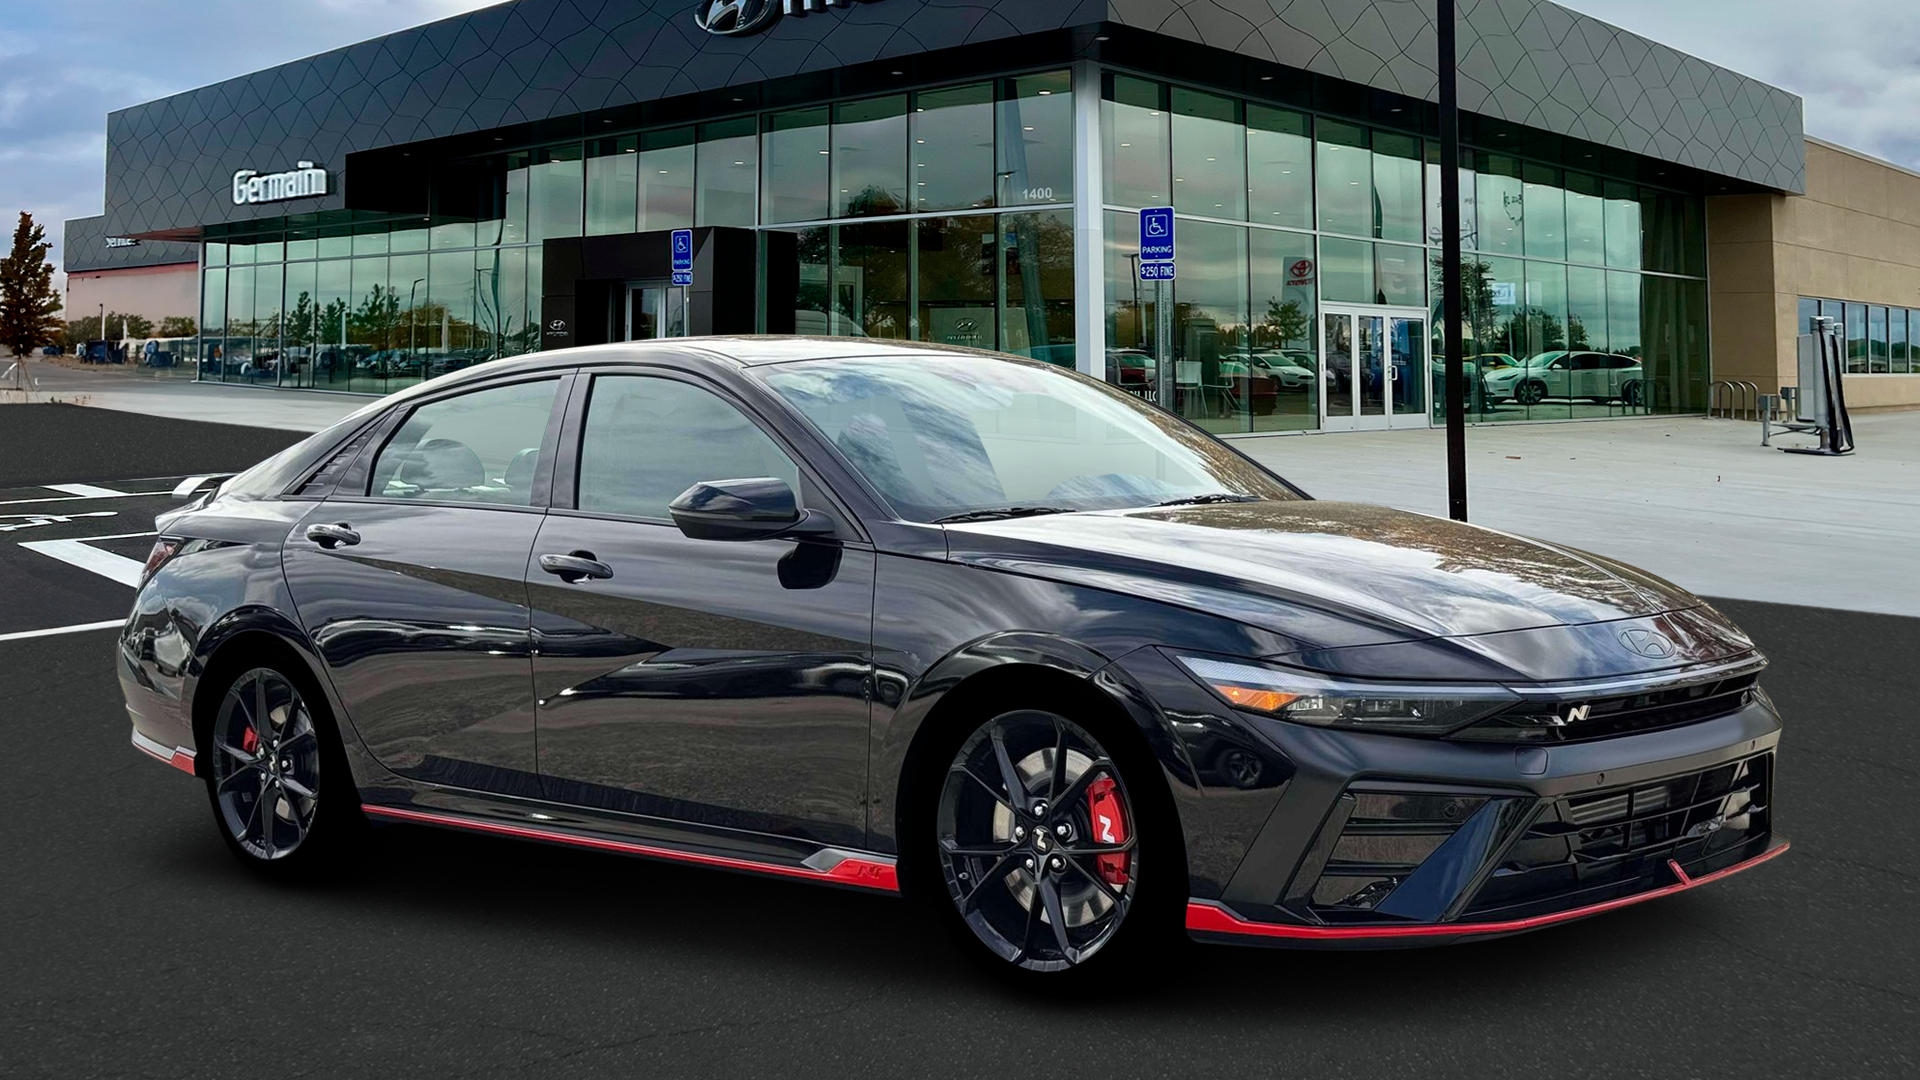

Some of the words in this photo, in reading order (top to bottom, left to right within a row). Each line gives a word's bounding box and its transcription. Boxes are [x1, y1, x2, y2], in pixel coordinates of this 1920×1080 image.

[232, 160, 328, 205] Germain
[1022, 187, 1053, 200] 1400
[1141, 245, 1173, 254] PARKING
[1141, 265, 1159, 277] $250
[1160, 265, 1174, 277] FINE
[1567, 704, 1592, 722] N
